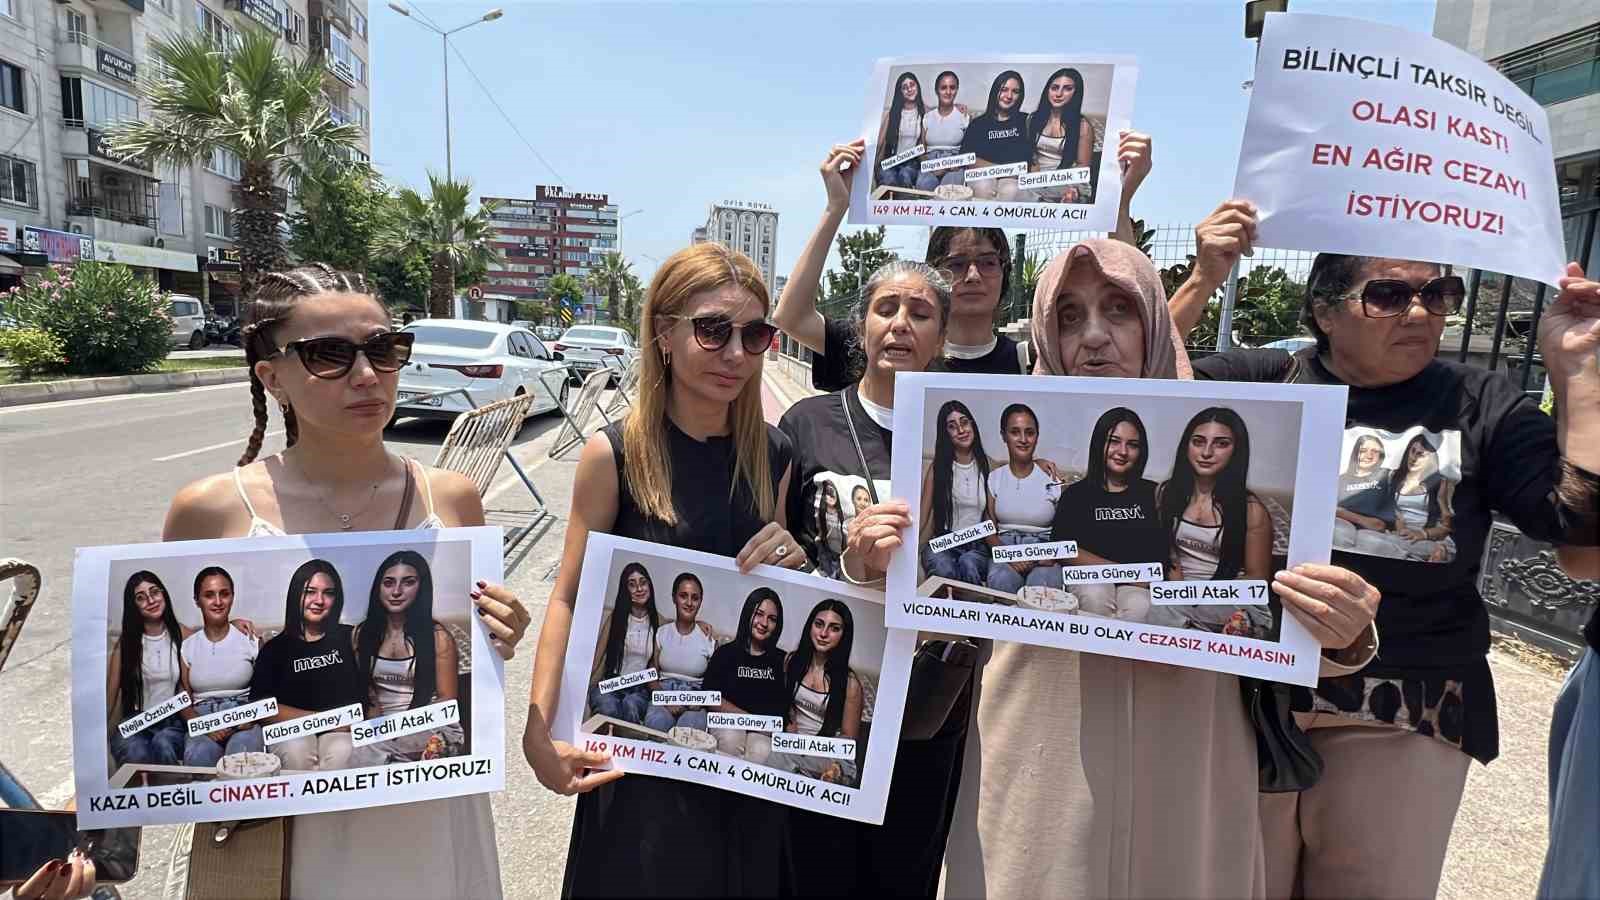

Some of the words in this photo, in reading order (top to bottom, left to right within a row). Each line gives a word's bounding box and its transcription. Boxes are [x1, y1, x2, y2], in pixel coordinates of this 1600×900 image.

[104, 53, 132, 71] AVUKAT
[1282, 46, 1400, 80] BİLİNÇLİ
[1410, 63, 1487, 106] TAKSİR
[1493, 95, 1543, 144] DEĞİL
[1352, 100, 1436, 131] OLASI
[1447, 115, 1509, 154] KAST!
[965, 169, 987, 179] Kübra
[988, 167, 1014, 176] Güney
[1018, 164, 1027, 172] 14
[1020, 175, 1048, 185] Serdil
[1050, 172, 1073, 181] Atak
[1078, 170, 1089, 179] 17
[1311, 143, 1352, 167] EN
[1362, 146, 1433, 176] AĞIR
[1444, 159, 1527, 200] CEZAYI
[873, 205, 889, 217] 149
[893, 205, 912, 217] KM
[939, 206, 945, 215] 4
[982, 207, 989, 216] 4
[994, 206, 1056, 218] ÖMÜRLÜK
[1061, 209, 1088, 219] ACI!
[1346, 190, 1505, 235] İSTİYORUZ!
[1095, 504, 1145, 521] mavi
[931, 537, 953, 551] Nejla
[952, 527, 981, 543] Öztürk
[983, 523, 994, 532] 16
[994, 548, 1023, 560] Büşra
[1024, 547, 1059, 559] Güney
[1063, 544, 1077, 554] 14
[1064, 568, 1099, 580] Kübra
[1101, 568, 1140, 581] Güney
[1147, 566, 1162, 577] 14
[1152, 586, 1197, 600] Serdil
[1202, 584, 1239, 599] Atak
[1247, 585, 1266, 598] 17
[903, 602, 980, 622] VİCDANLARI
[985, 612, 1065, 633] YARALAYAN
[1069, 623, 1089, 636] BU
[1094, 626, 1134, 642] OLAY
[1139, 632, 1203, 651] CEZASIZ
[1207, 641, 1296, 667] KALMASIN!
[293, 650, 343, 673] mavi
[620, 673, 646, 685] Öztürk
[647, 670, 657, 678] 16
[653, 693, 678, 705] Büşra
[679, 693, 707, 704] Güney
[711, 693, 721, 701] 14
[120, 718, 144, 735] Nejla
[144, 703, 175, 722] Öztürk
[177, 694, 189, 706] 16
[189, 717, 221, 733] Büşra
[222, 707, 259, 723] Güney
[263, 701, 277, 713] 14
[264, 724, 300, 741] Kübra
[302, 712, 342, 731] Güney
[347, 707, 362, 720] 14
[353, 719, 397, 741] Serdil
[400, 710, 434, 729] Atak
[441, 704, 457, 720] 17
[708, 715, 735, 725] Kübra
[737, 716, 767, 729] Güney
[772, 719, 782, 729] 14
[773, 735, 806, 750] Serdil
[808, 739, 836, 753] Atak
[841, 744, 855, 755] 17
[89, 794, 140, 812] KAZA
[147, 788, 203, 808] DEĞİL
[209, 782, 294, 804] CİNAYET.
[301, 772, 380, 796] ADALET
[386, 758, 492, 787] İSTİYORUZ!
[612, 743, 636, 759] KM
[673, 754, 681, 766] 4
[727, 765, 736, 777] 4
[741, 768, 816, 798] ÖMÜRLÜK
[820, 789, 851, 806] ACI!
